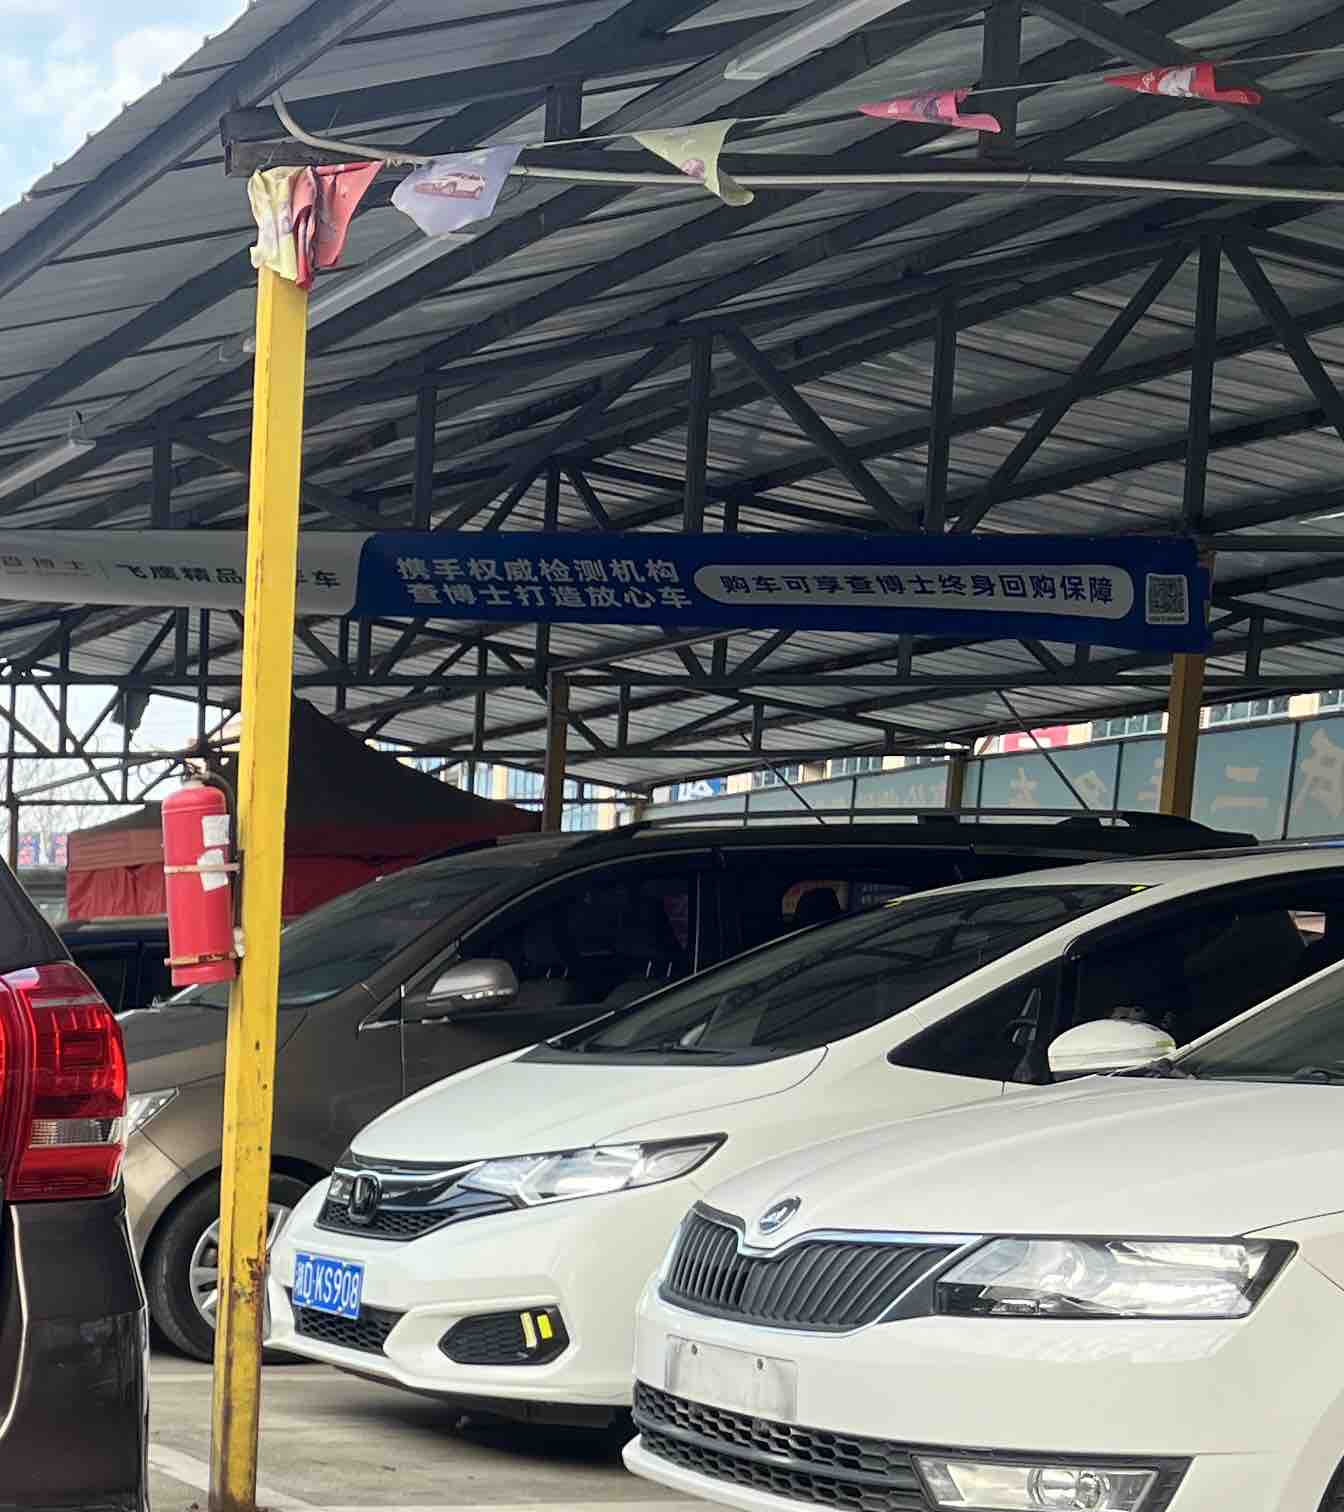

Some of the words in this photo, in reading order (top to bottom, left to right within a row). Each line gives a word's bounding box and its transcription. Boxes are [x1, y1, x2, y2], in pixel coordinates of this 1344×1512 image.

[114, 560, 342, 589] 飞鹰精品车
[397, 557, 681, 585] 携手权威检测机构
[407, 583, 693, 609] 查博士打造放心车
[718, 573, 1115, 605] 购车可享查博士终身回购保障
